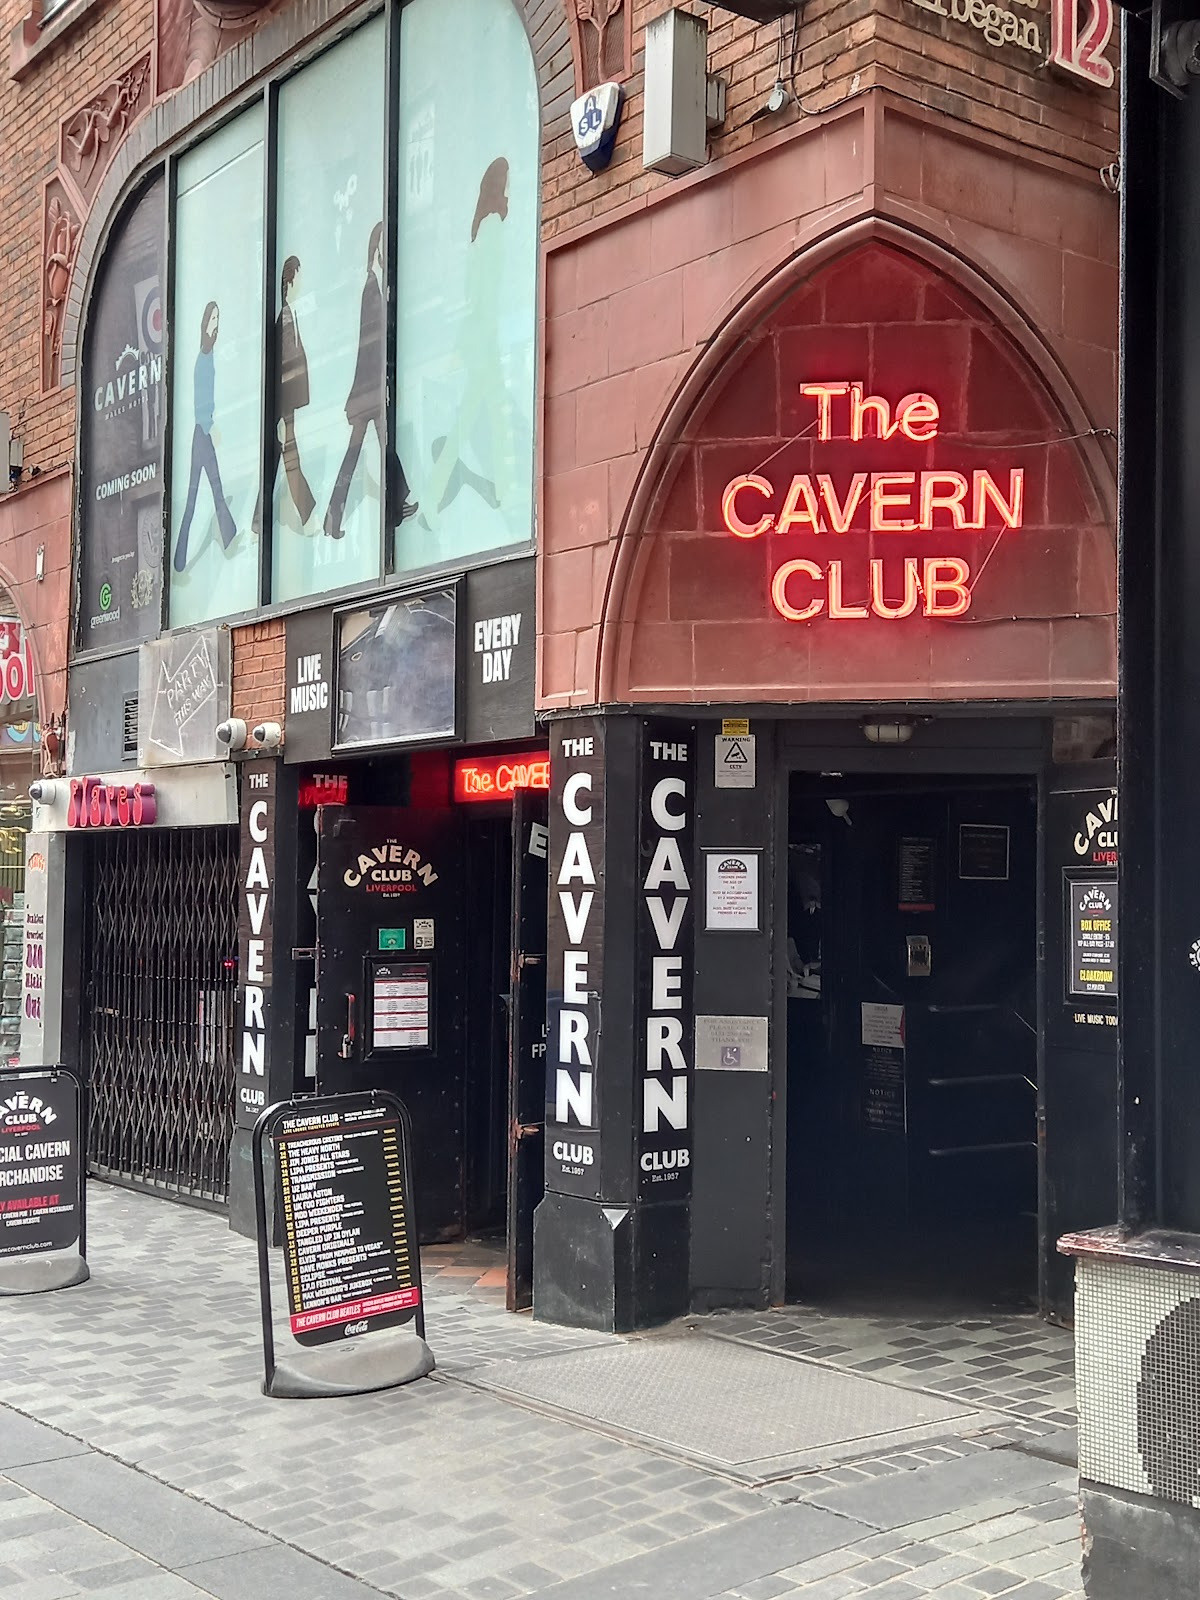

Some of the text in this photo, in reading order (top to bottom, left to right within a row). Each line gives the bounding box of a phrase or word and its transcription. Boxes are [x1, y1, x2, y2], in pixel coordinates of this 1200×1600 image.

[94, 357, 162, 412] CAVERN
[800, 377, 940, 441] The
[95, 463, 156, 500] COMING SOON
[722, 468, 1024, 538] CAVERN
[771, 557, 972, 620] CLUB
[91, 606, 120, 628] greenwood
[474, 613, 521, 652] EVERY
[297, 653, 322, 684] LIVE
[482, 648, 512, 683] DAY
[291, 681, 328, 714] MUSIC
[562, 737, 594, 757] THE
[650, 741, 687, 761] THE
[249, 773, 268, 789] THE
[313, 774, 348, 788] THE
[462, 768, 494, 793] The
[343, 845, 438, 887] CAVERN
[371, 870, 412, 881] CLUB
[720, 860, 745, 870] CAVERN
[366, 884, 417, 892] LIVERPOOL
[1080, 889, 1111, 911] CAVERN
[1093, 920, 1111, 931] OFFICE
[242, 800, 270, 1076] CAVERN
[556, 772, 597, 1127] CAVERN
[643, 777, 691, 1133] CAVERN
[1080, 970, 1112, 982] CLOAKROOM
[1087, 1015, 1104, 1025] MUSIC
[240, 1087, 265, 1105] CLUB
[0, 1095, 57, 1125] AVERN
[5, 1114, 37, 1125] CLUB
[282, 1119, 296, 1128] THE
[297, 1116, 321, 1126] CAVERN
[322, 1113, 338, 1122] CLUB
[1, 1125, 41, 1133] LIVERPOOL
[25, 1140, 70, 1160] CAVERN
[288, 1143, 340, 1158] THE HEAVY NORTH
[553, 1141, 594, 1165] CLUB
[640, 1149, 690, 1171] CLUB
[8, 1196, 47, 1210] AVAILABLE
